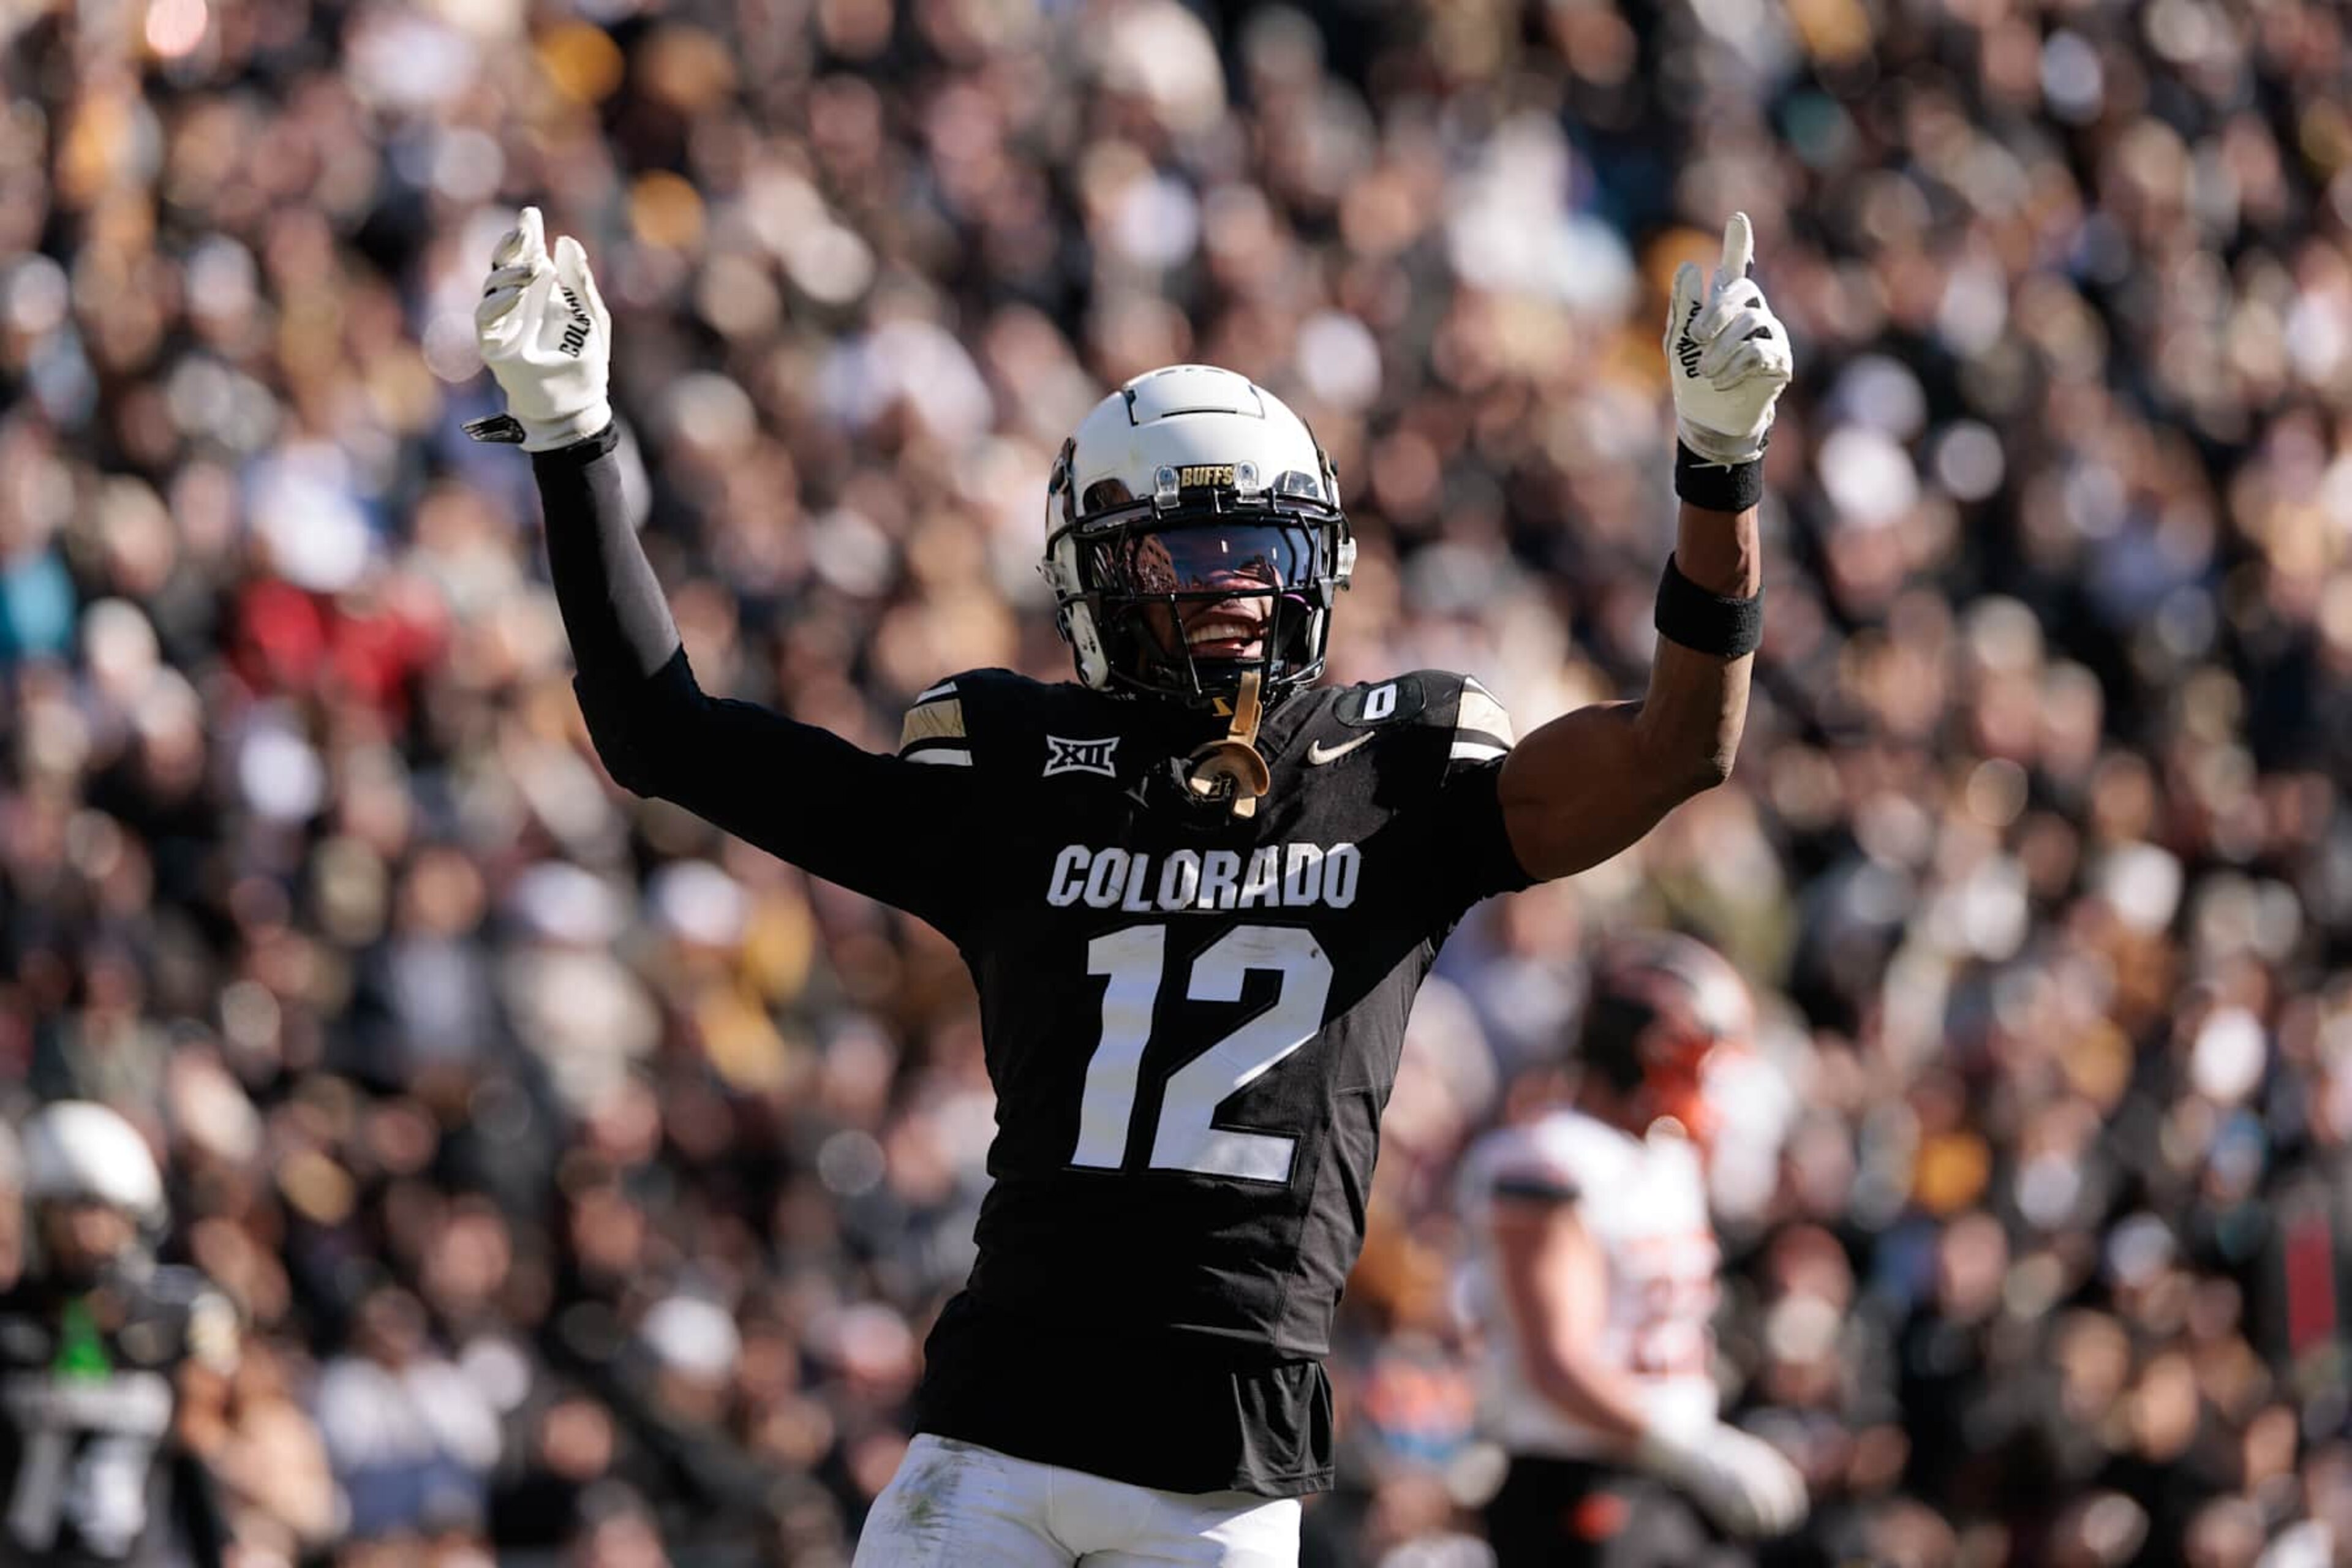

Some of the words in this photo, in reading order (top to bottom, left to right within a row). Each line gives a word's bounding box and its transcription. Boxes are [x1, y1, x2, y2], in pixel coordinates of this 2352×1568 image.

[1181, 466, 1234, 488] BUFFS
[1046, 737, 1118, 775] XII
[1046, 842, 1361, 911] COLORADO
[1071, 924, 1335, 1183] 12
